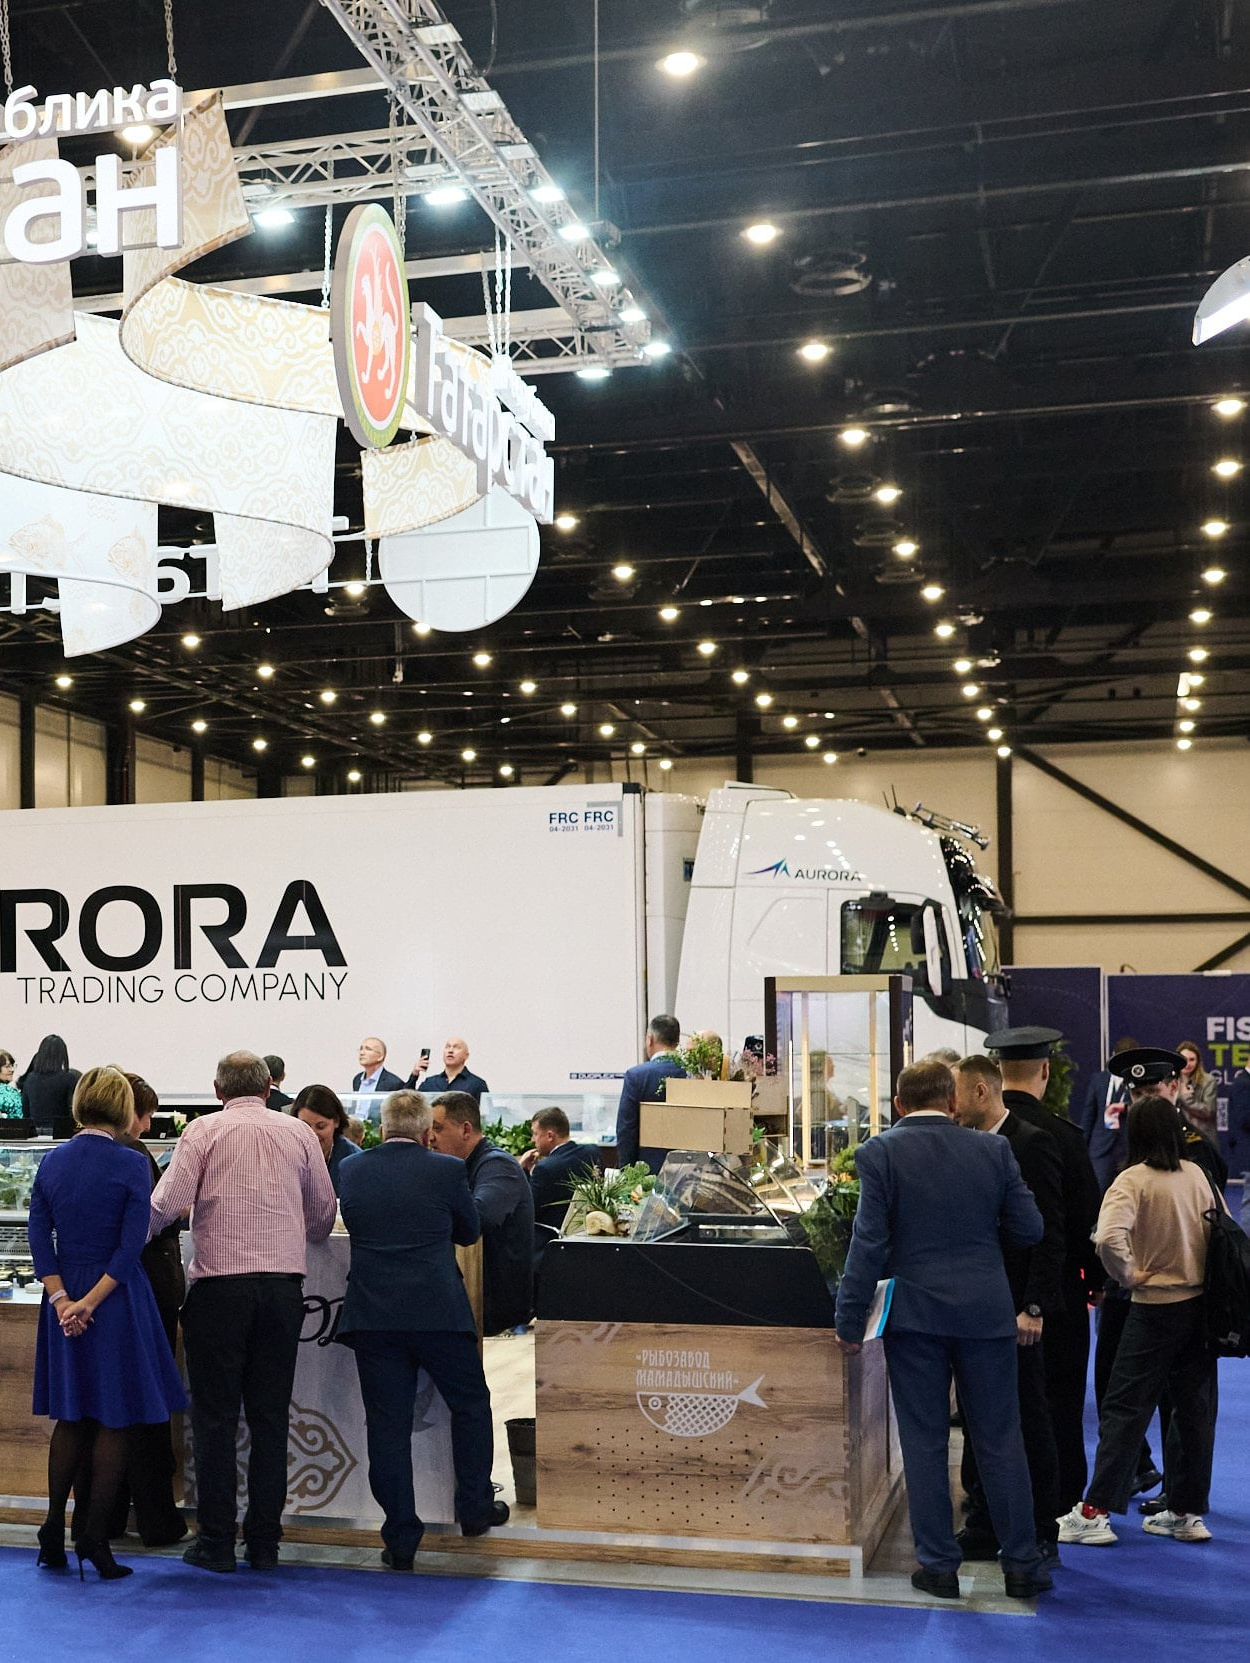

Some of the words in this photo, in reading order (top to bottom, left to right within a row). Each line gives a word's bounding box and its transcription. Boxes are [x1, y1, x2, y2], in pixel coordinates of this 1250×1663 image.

[548, 811, 579, 824] FRC
[583, 810, 614, 823] FRC
[793, 868, 862, 882] AURORA
[17, 974, 164, 1004] TRADING
[174, 972, 349, 1002] COMPANY
